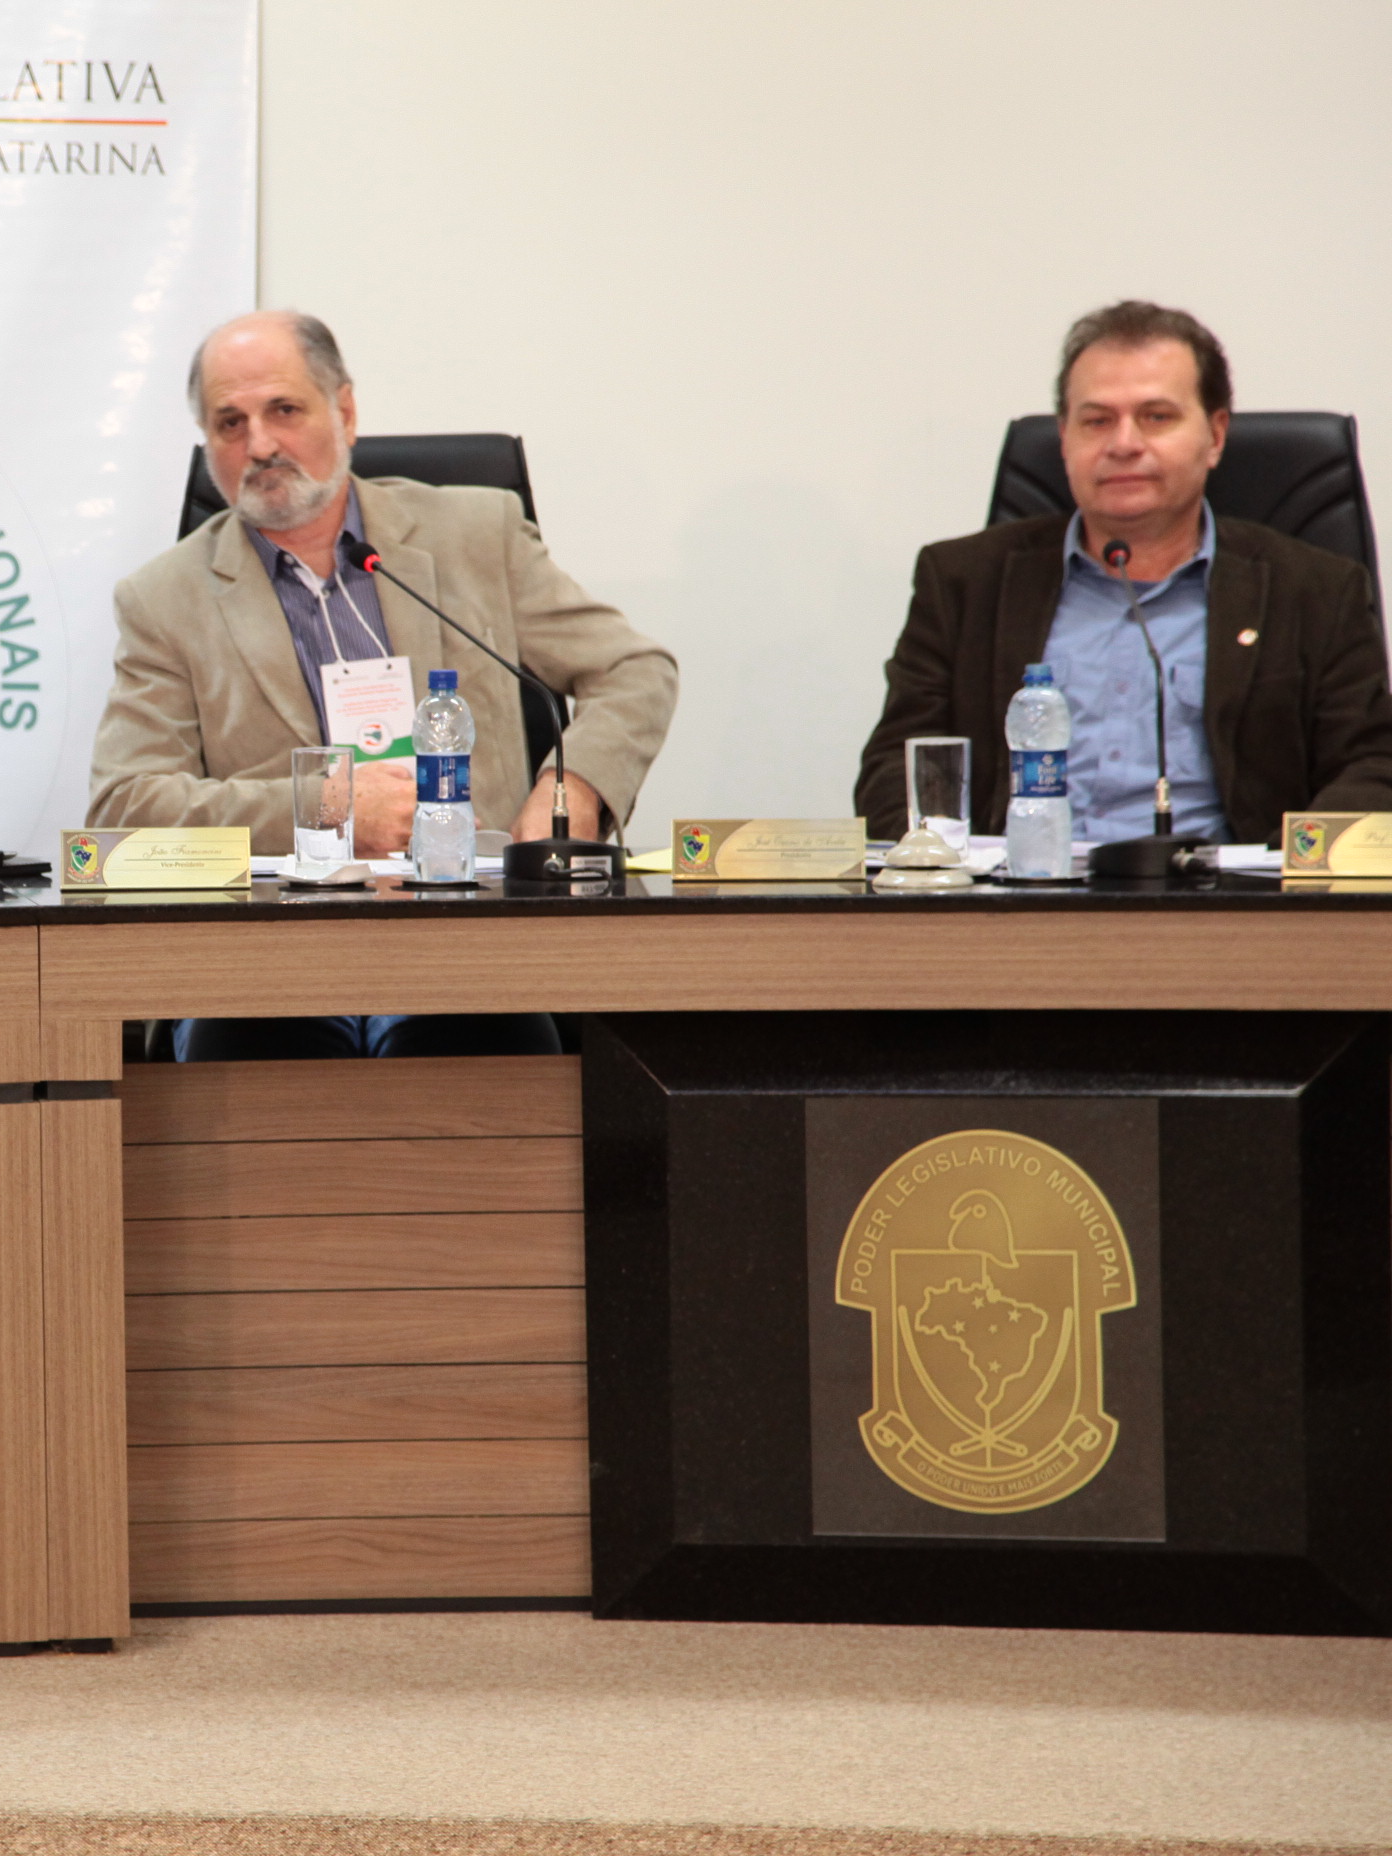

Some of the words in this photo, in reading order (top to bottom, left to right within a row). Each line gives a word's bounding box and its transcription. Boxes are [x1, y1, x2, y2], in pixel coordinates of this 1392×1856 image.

[850, 1207, 893, 1295] PODER
[885, 1146, 1041, 1208] LEGISLATIVO
[1045, 1169, 1123, 1298] MUNICIPAL
[963, 1481, 997, 1498] UNIDO
[1008, 1476, 1034, 1493] MAIS
